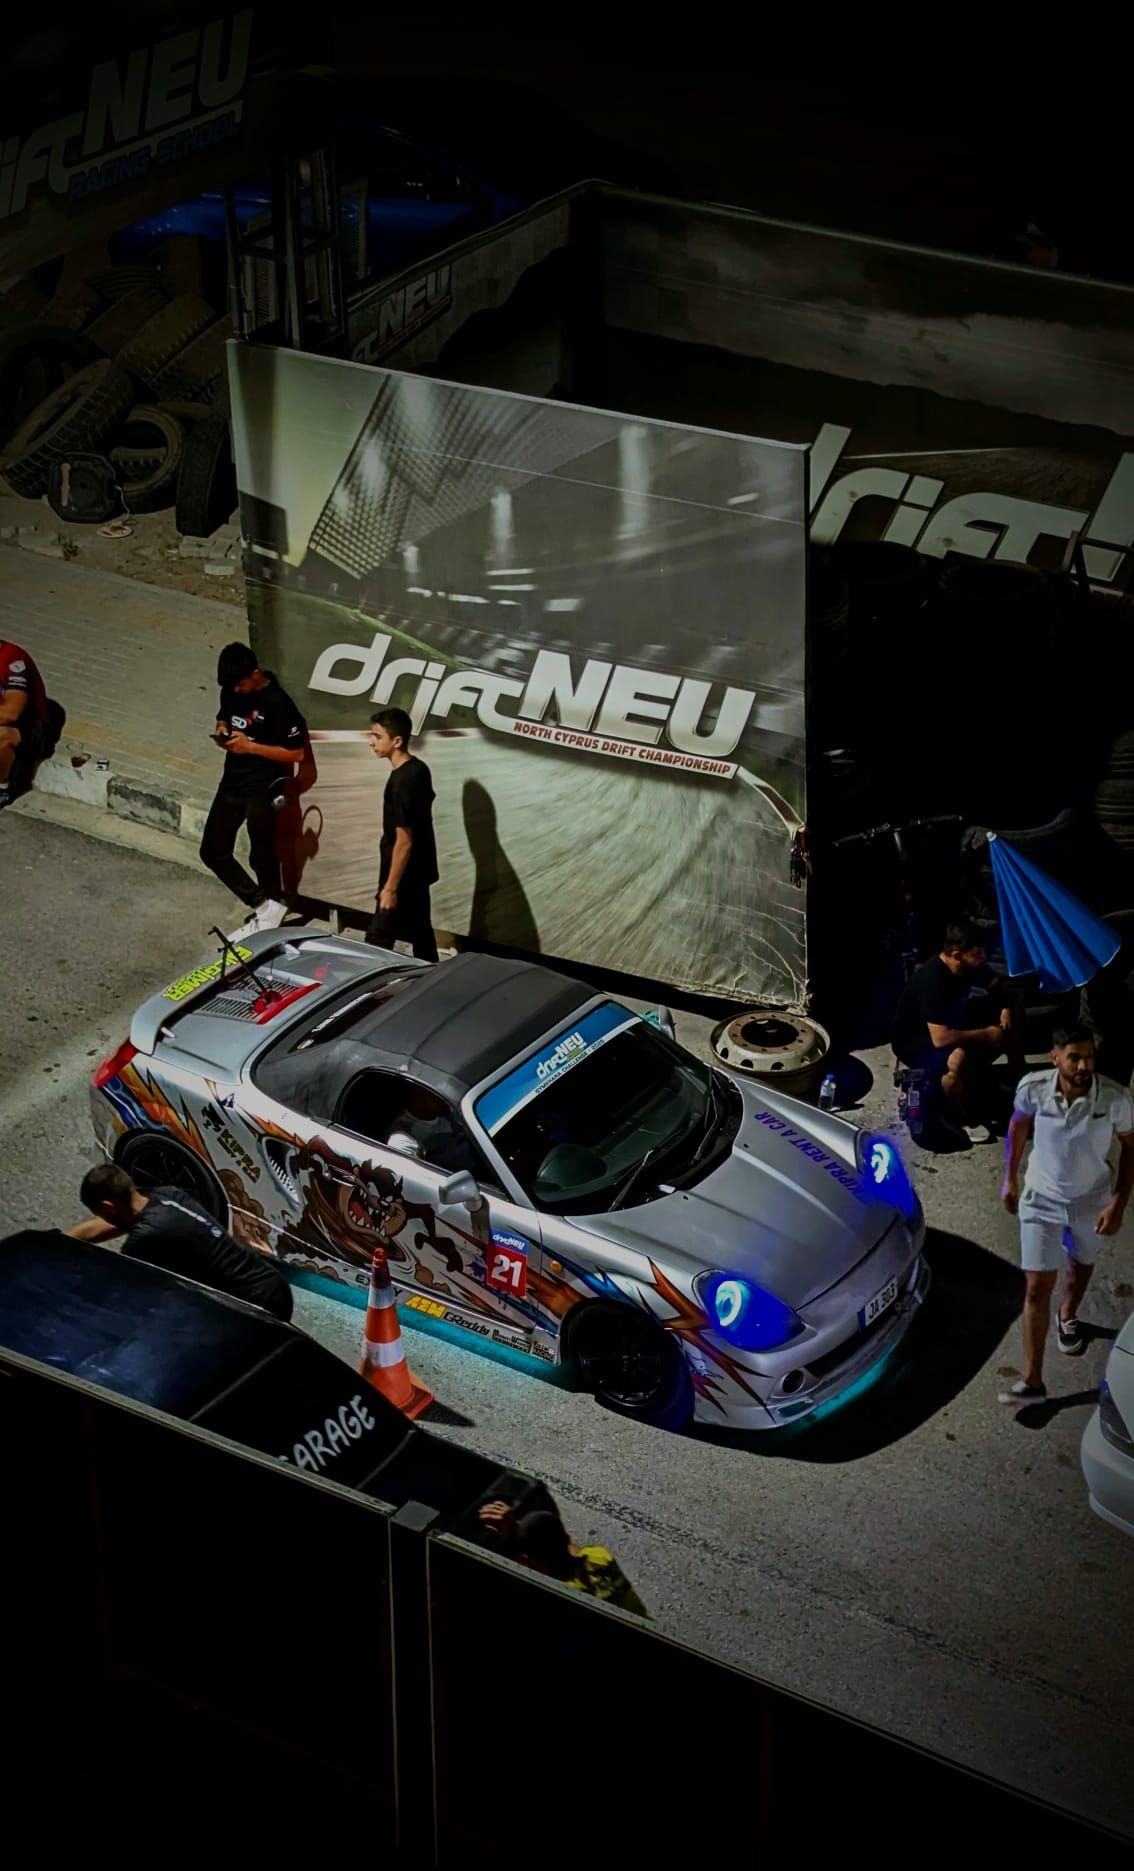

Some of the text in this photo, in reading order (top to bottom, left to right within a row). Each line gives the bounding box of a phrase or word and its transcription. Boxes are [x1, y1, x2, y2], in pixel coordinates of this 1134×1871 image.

[69, 143, 151, 201] RACING
[514, 721, 731, 775] NORTH CYPRUS DRIFT CHAMPIONSHIP
[754, 1111, 865, 1195] KIPRA RENT A CAR
[490, 1254, 523, 1289] 21
[278, 1394, 376, 1473] ARAGE
